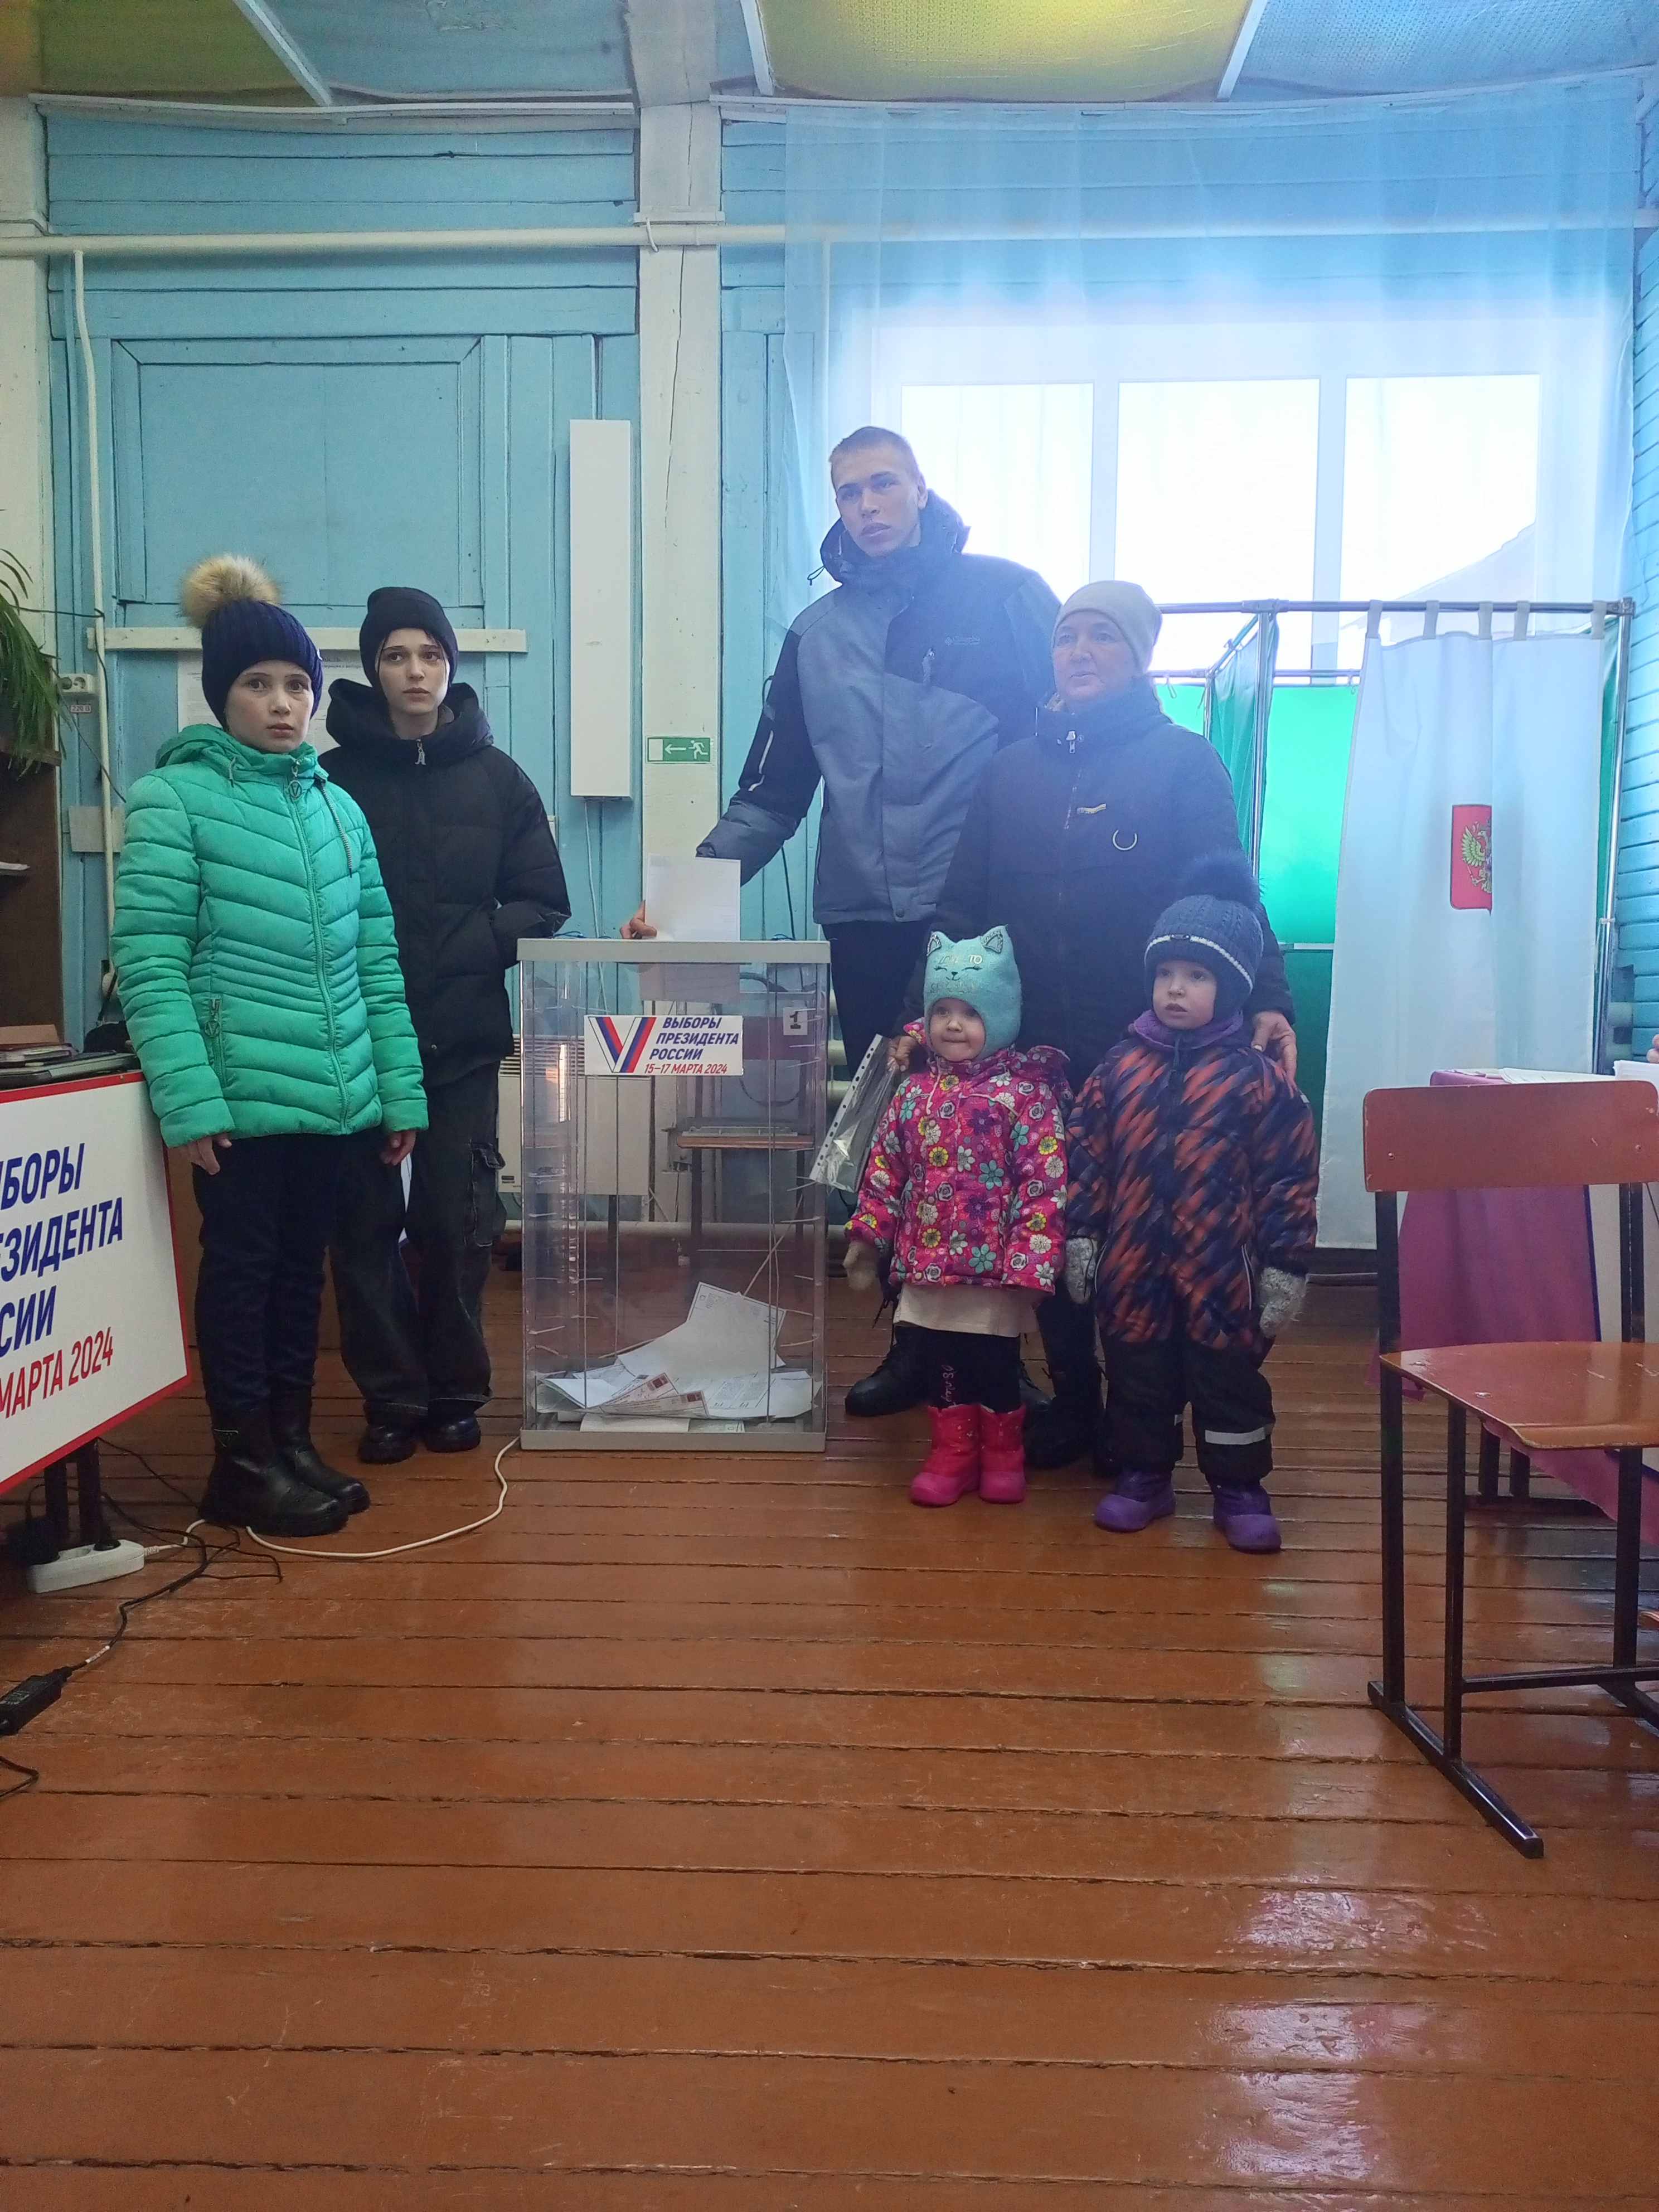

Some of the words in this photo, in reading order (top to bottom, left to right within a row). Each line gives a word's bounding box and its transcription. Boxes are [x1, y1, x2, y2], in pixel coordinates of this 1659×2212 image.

[969, 954, 983, 964] TO
[662, 1017, 722, 1029] ВЫБОРЫ
[789, 1011, 801, 1029] 1
[656, 1032, 739, 1046] ПРЕЗИДЕНТА
[649, 1049, 704, 1060] РОССИИ
[671, 1064, 703, 1074] МАРТА
[704, 1064, 728, 1074] 2024
[0, 1143, 85, 1210] БОРЫ
[0, 1197, 123, 1282] ЗИДЕНТА
[69, 1326, 113, 1386] 2024
